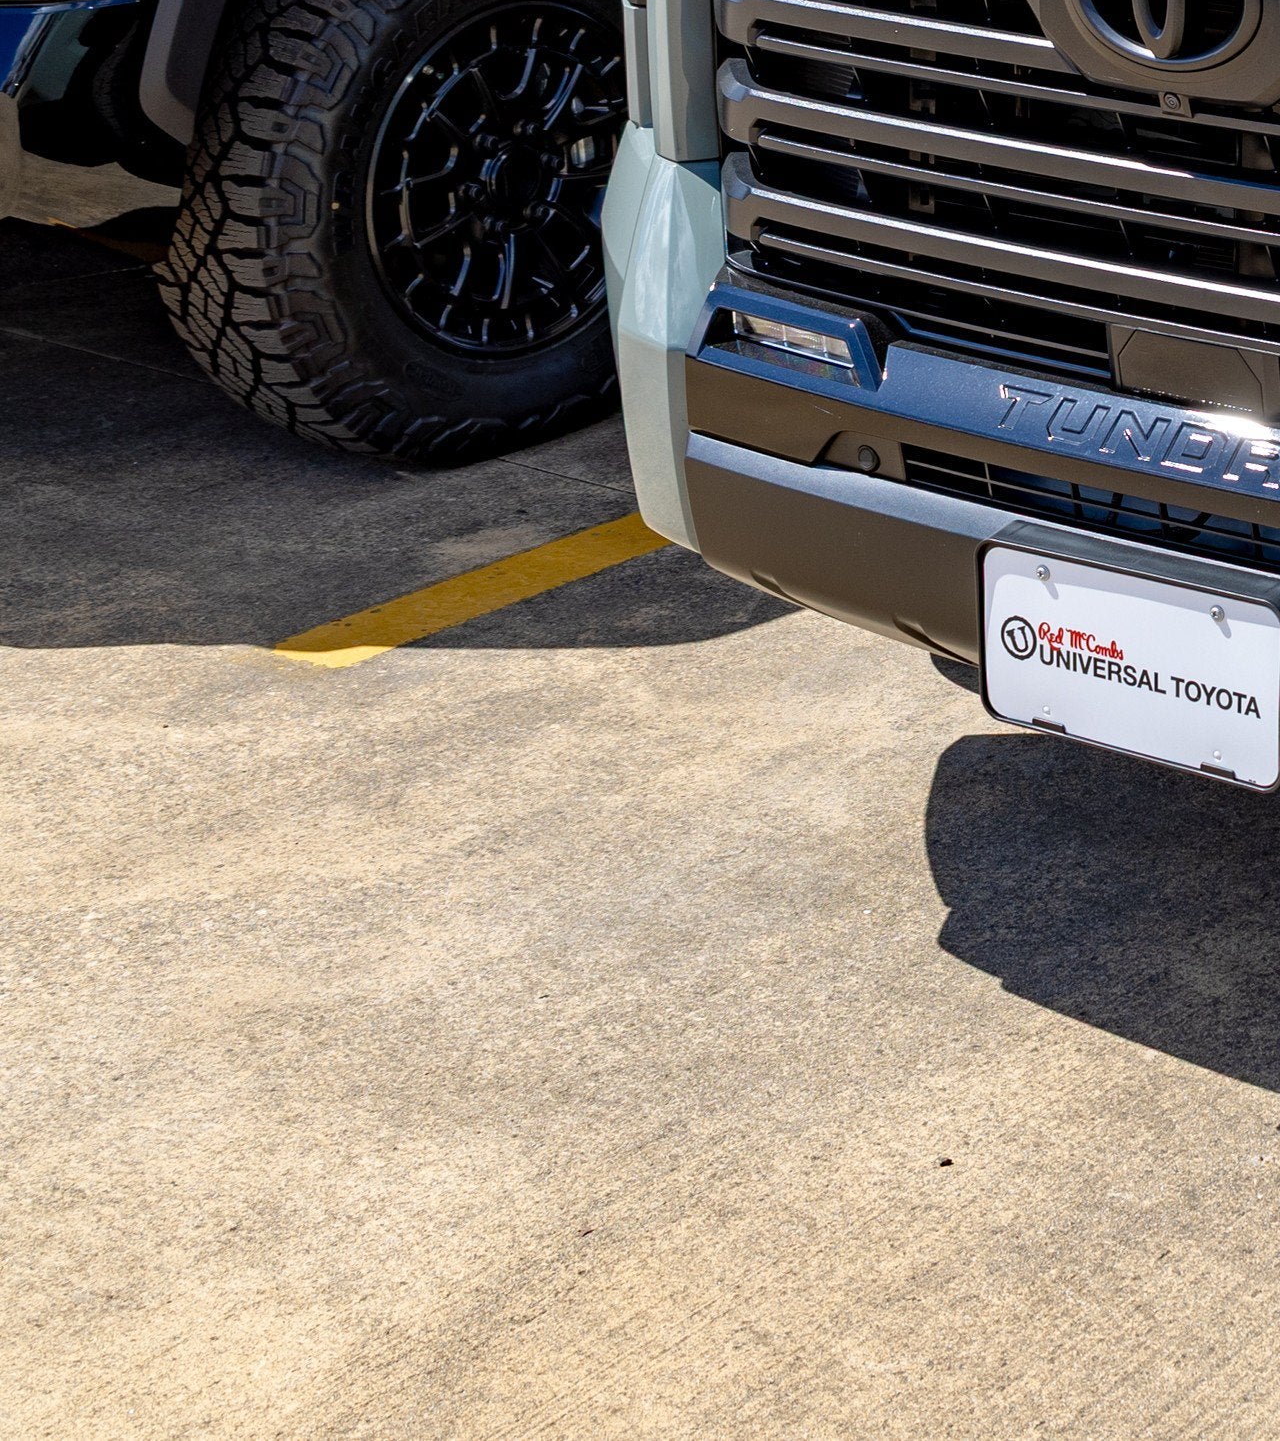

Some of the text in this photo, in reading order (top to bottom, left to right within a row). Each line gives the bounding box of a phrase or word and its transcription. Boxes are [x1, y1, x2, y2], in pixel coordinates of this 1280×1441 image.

[1038, 622, 1124, 660] Red McCombs
[1039, 643, 1262, 719] UNIVERSAL TOYOTA
